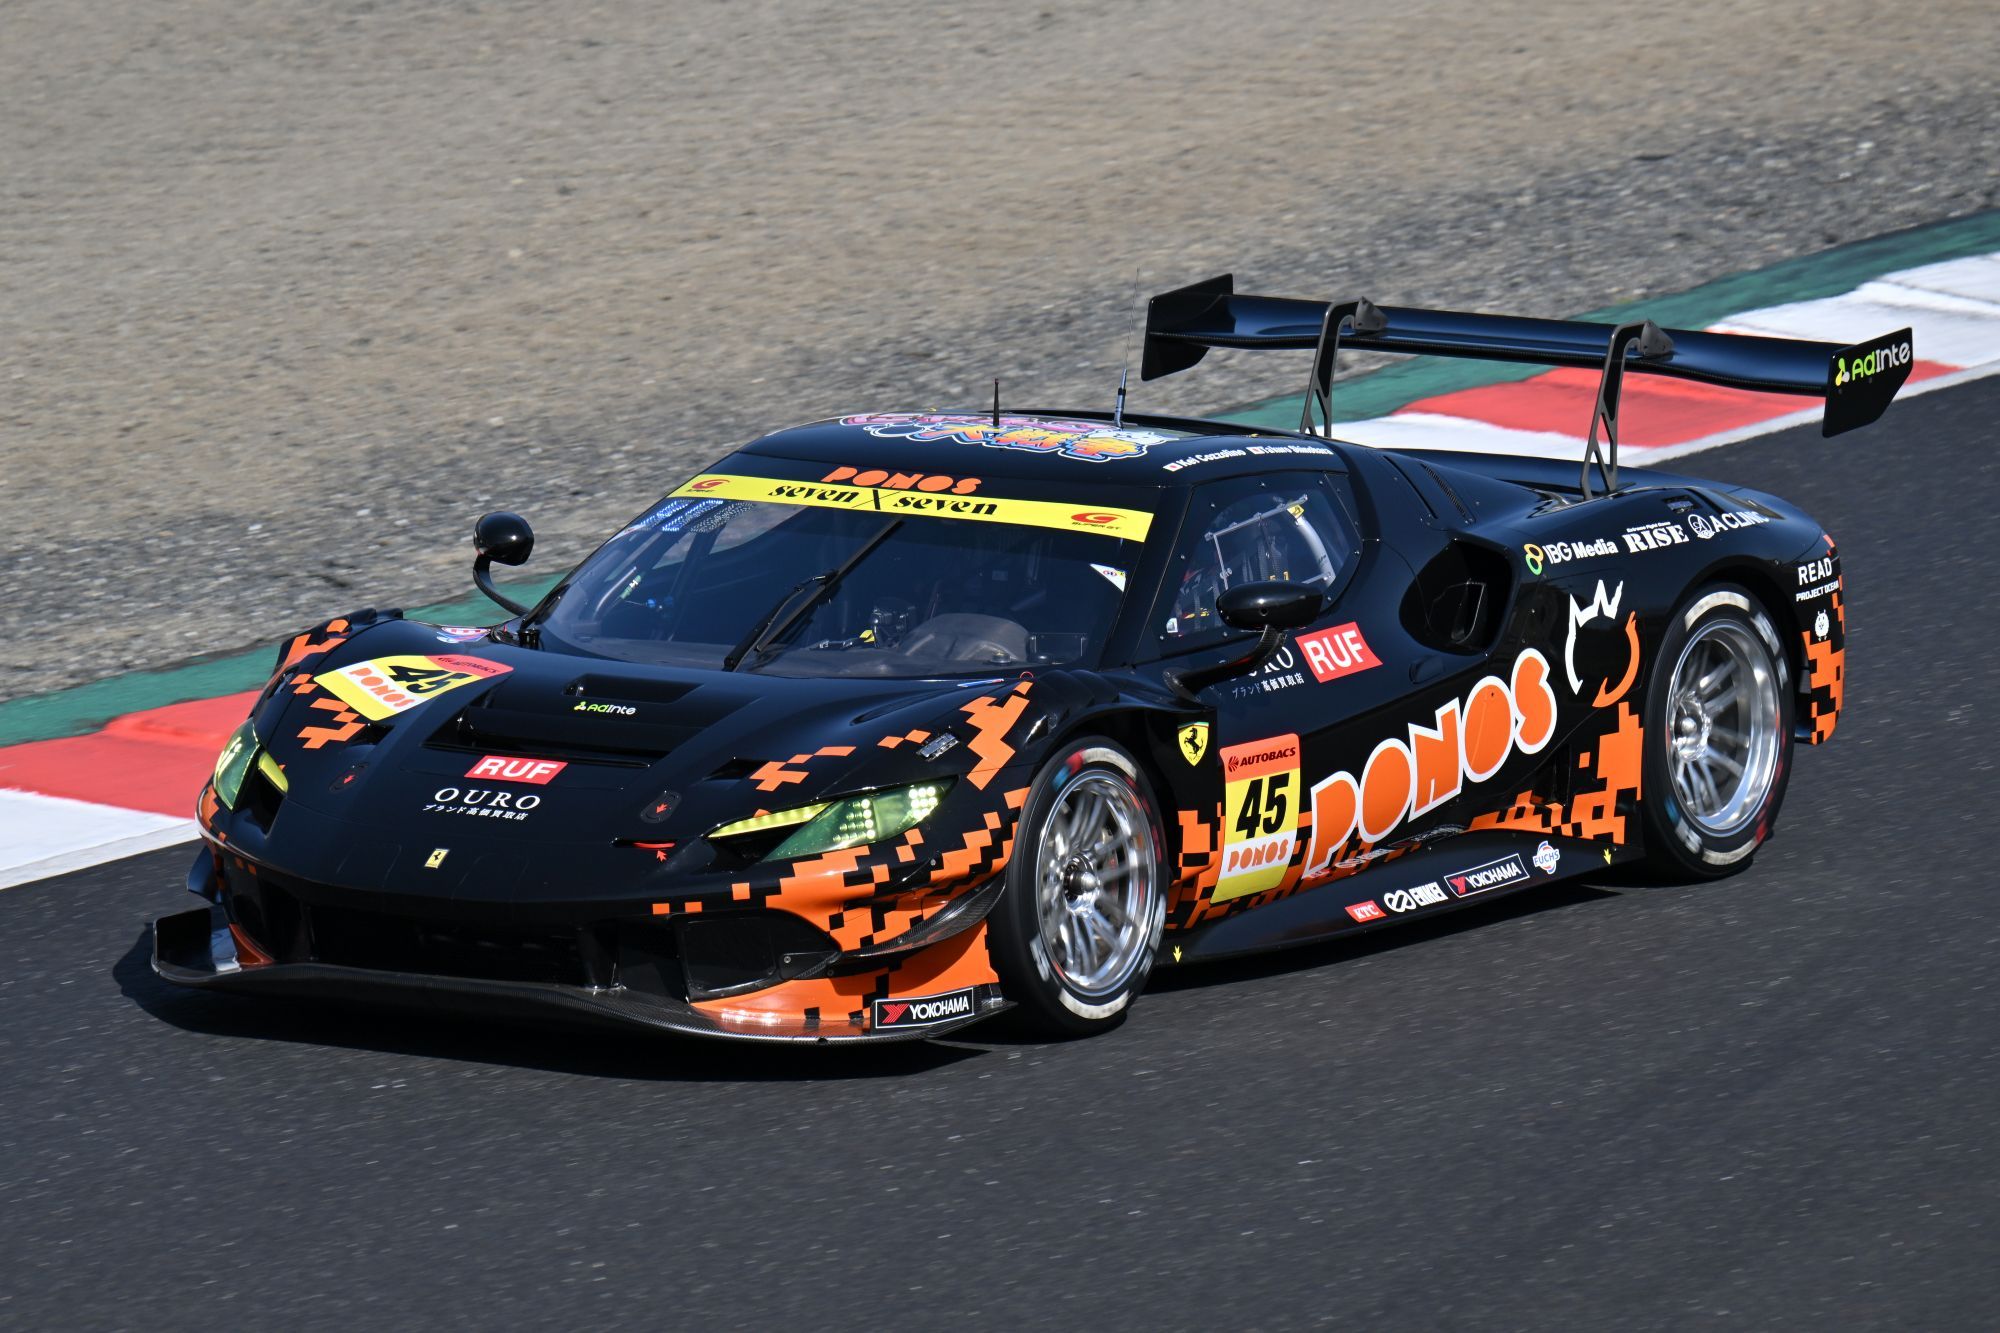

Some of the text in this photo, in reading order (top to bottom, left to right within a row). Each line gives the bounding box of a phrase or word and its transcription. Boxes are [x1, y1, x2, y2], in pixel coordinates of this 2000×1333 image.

[821, 466, 982, 495] PONOS
[768, 484, 860, 503] seven
[894, 496, 998, 516] seven
[1573, 538, 1618, 560] Media
[1622, 524, 1689, 553] RISE
[1798, 557, 1832, 585] READ
[1796, 586, 1824, 602] PROJECT
[1303, 630, 1364, 675] RUF
[349, 667, 415, 708] PONOS
[388, 665, 472, 694] 45
[474, 758, 559, 779] RUF
[1240, 747, 1297, 767] AUTOBACS
[1301, 647, 1558, 880] PONOS
[434, 787, 541, 810] OURO
[1236, 772, 1290, 840] 45
[422, 804, 529, 821] ブランド高価買取店
[1227, 838, 1289, 872] PONOS
[1534, 850, 1561, 868] FUCHS
[1465, 862, 1523, 889] YOKOHAMA
[1353, 903, 1380, 920] KTC
[909, 996, 970, 1020] YOKOHAMA
